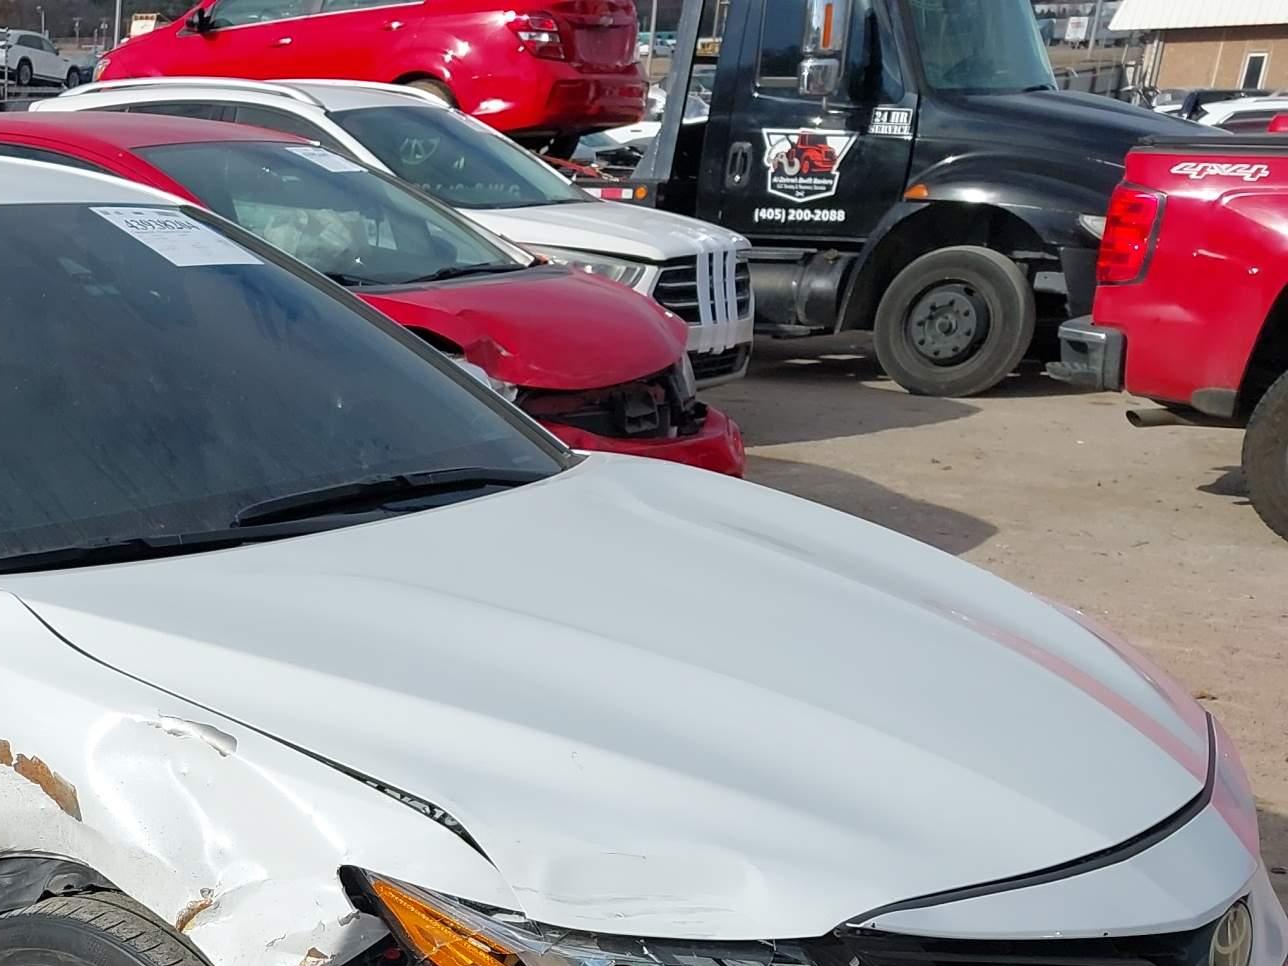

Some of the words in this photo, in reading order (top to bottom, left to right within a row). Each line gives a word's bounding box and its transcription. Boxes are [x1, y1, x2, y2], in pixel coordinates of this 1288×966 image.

[874, 111, 889, 123] 24
[889, 111, 909, 123] HR
[754, 208, 786, 223] (405)
[787, 208, 846, 221] 200-2088
